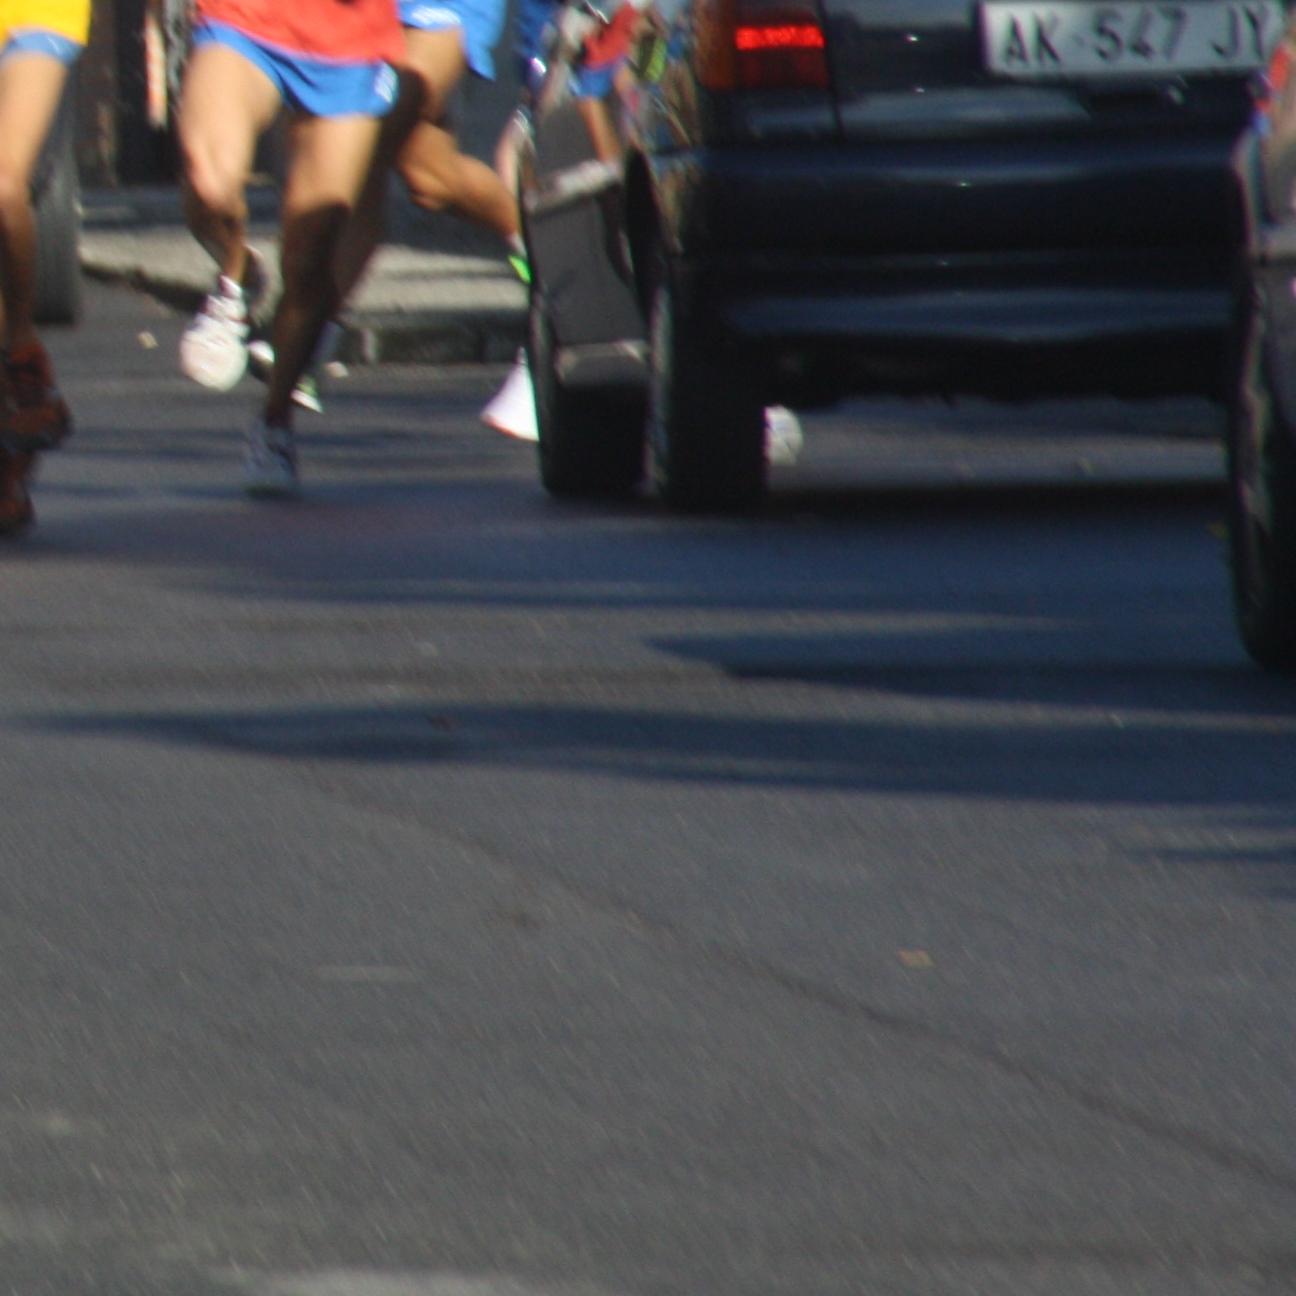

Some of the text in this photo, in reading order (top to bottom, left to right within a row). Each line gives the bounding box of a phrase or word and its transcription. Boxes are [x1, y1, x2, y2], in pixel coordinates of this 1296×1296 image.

[1003, 2, 1271, 65] AK 547 JY
